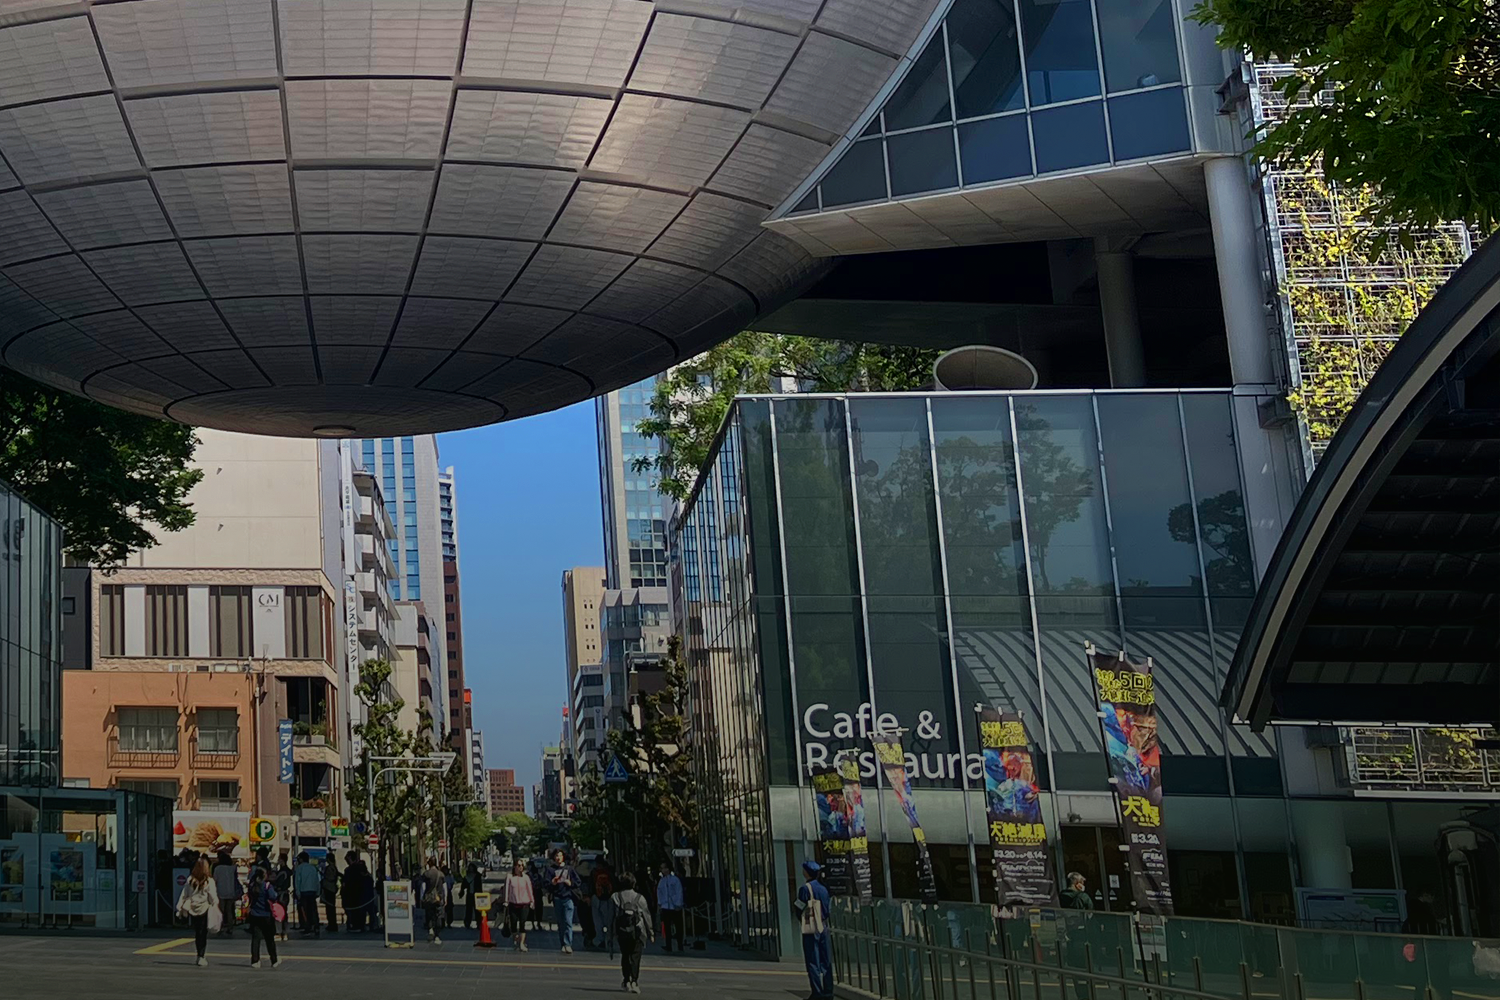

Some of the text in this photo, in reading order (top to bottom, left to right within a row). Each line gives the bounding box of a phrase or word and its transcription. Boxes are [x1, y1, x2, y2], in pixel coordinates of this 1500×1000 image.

[803, 702, 900, 738] Cafe
[916, 709, 942, 739] &
[260, 822, 271, 838] P
